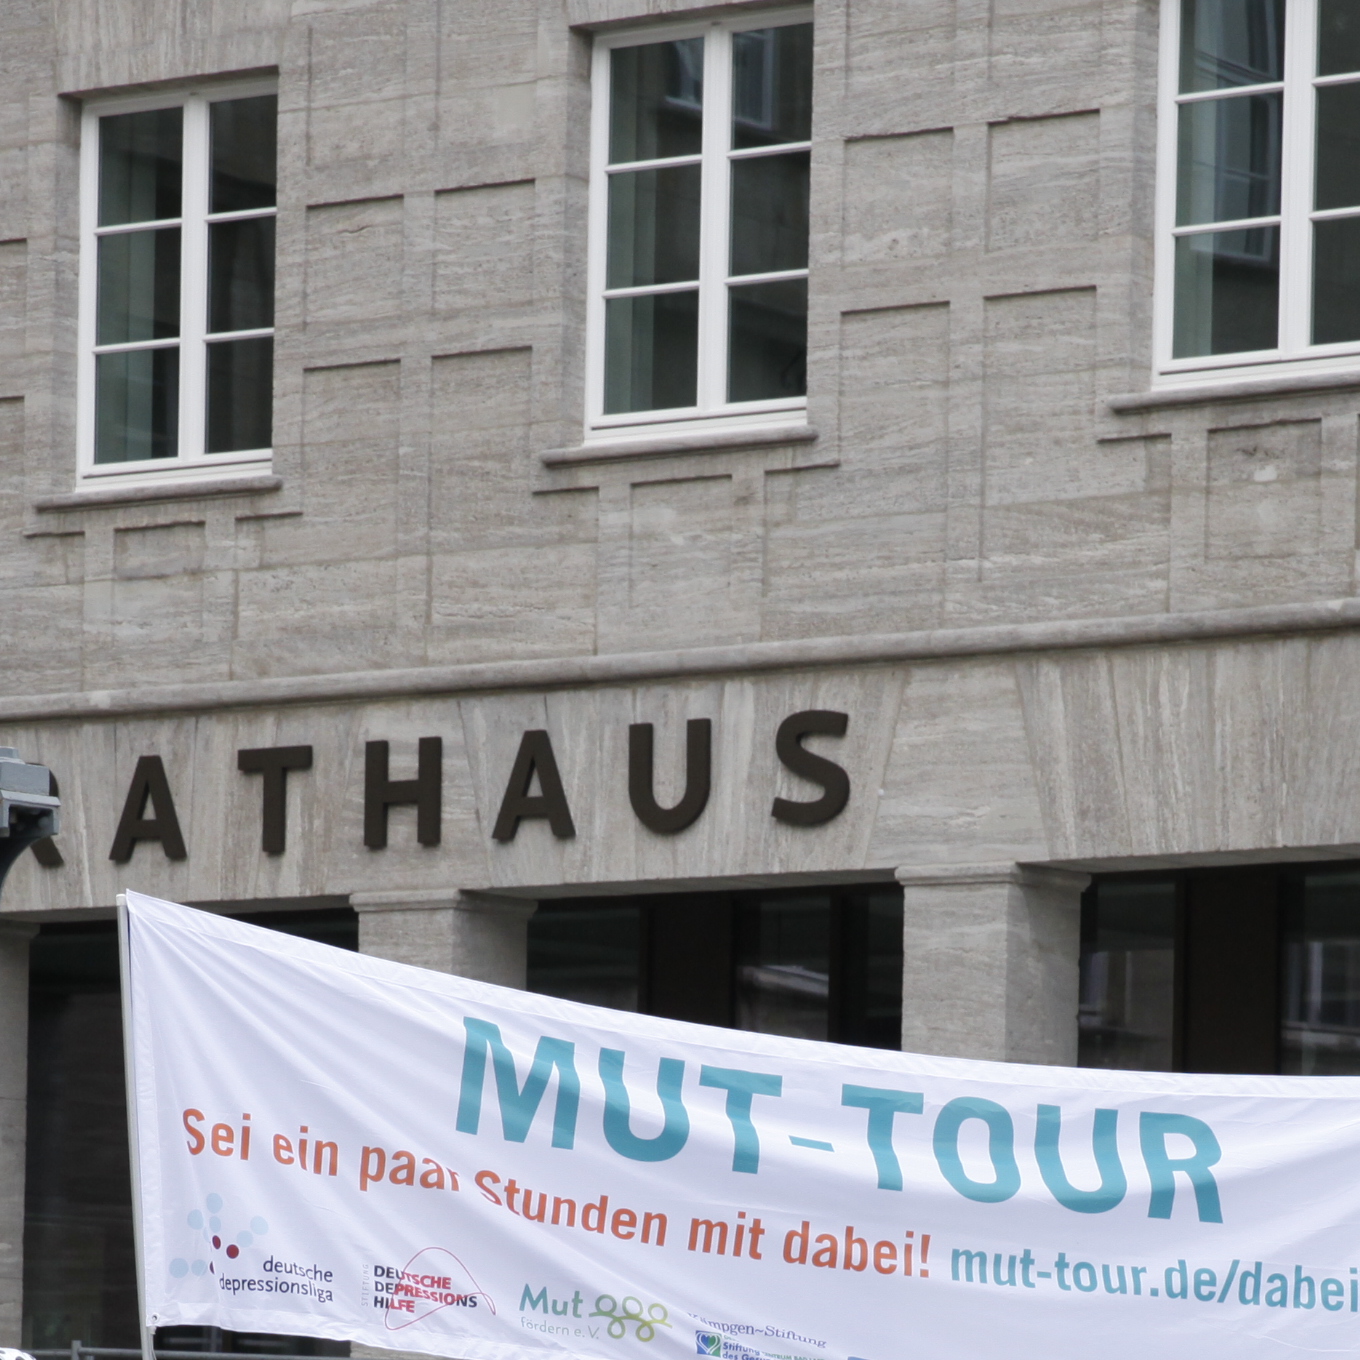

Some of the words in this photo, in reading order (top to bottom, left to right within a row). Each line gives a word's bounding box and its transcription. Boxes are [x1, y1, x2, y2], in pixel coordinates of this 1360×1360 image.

[455, 1016, 1224, 1224] MUT-TOUR
[182, 1108, 251, 1160] Sei
[273, 1125, 338, 1176] ein
[358, 1143, 462, 1192] paar
[474, 1169, 685, 1246] Stunden
[688, 1211, 764, 1261] mit
[783, 1221, 931, 1278] dabei!
[263, 1255, 333, 1283] deutsche
[374, 1265, 451, 1290] DEUTSCHE
[219, 1273, 333, 1303] depressionsliga
[361, 1263, 369, 1307] STIFTUNG
[374, 1281, 477, 1308] DEPRESSIONS
[374, 1296, 415, 1313] HILFE
[519, 1283, 583, 1319] Mut
[520, 1316, 569, 1337] fördern
